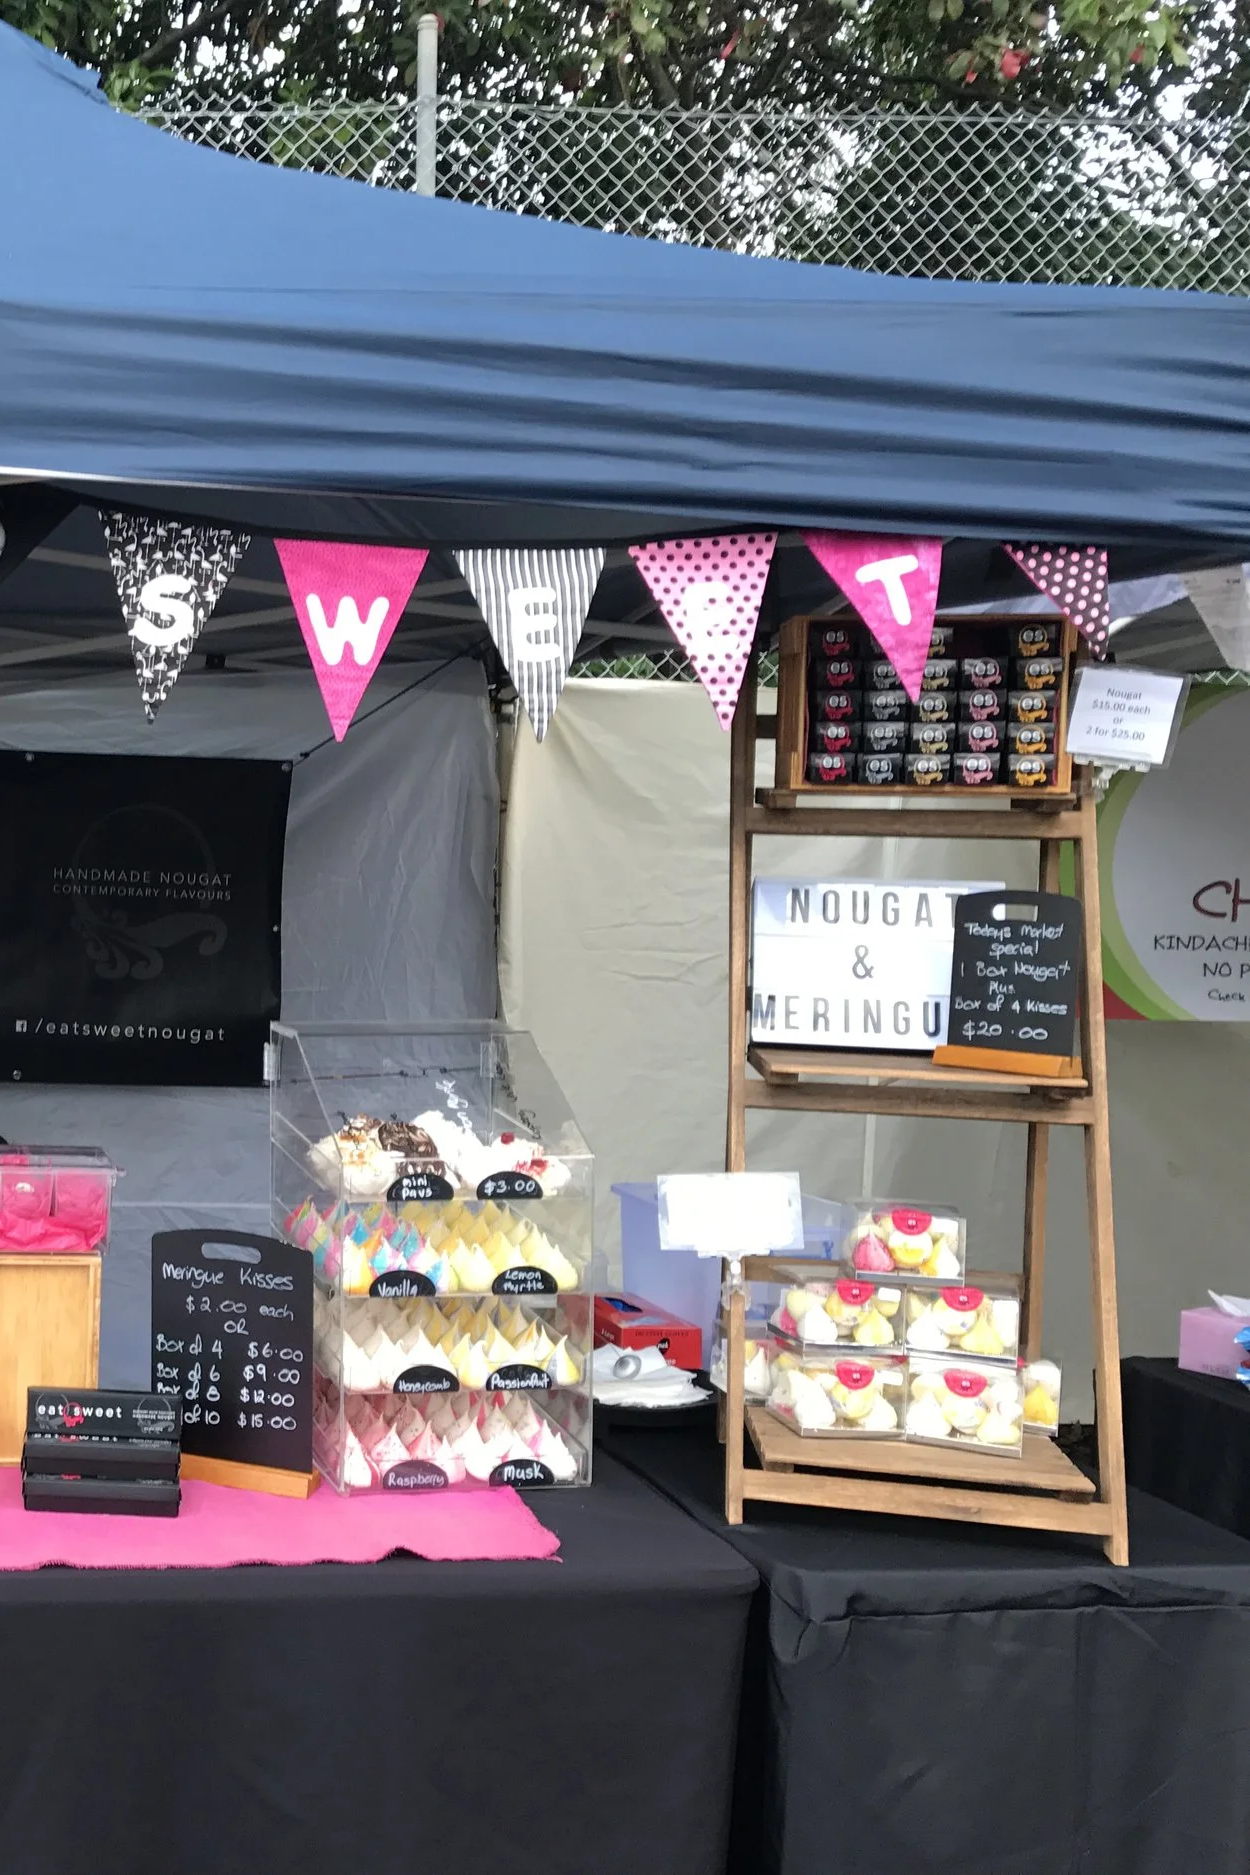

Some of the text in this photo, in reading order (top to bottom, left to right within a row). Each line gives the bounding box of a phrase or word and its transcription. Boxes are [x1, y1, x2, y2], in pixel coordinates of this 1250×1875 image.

[1106, 688, 1142, 700] Nougat
[1092, 700, 1151, 715] $15.00 each
[1113, 717, 1124, 725] or
[1086, 726, 1145, 741] 2 for $25.00
[53, 867, 232, 887] HANDMADE NOUGAT
[53, 884, 232, 901] CONTEMPORARY FLAVOURS
[791, 887, 962, 928] NOUGAT
[1154, 934, 1250, 951] KINDACH
[852, 944, 875, 979] &
[976, 961, 1008, 977] Box
[1014, 960, 1070, 981] Nougat
[1203, 962, 1232, 978] NO
[955, 996, 982, 1011] Box
[987, 994, 1005, 1012] of
[1011, 1000, 1020, 1014] 4
[484, 1179, 536, 1196] $3.00
[162, 1262, 294, 1291] Meringue Kisses
[377, 1279, 419, 1297] Vanilla
[259, 1304, 294, 1322] each
[155, 1333, 185, 1354] Box
[212, 1339, 223, 1360] 4
[157, 1362, 179, 1380] Box
[210, 1364, 221, 1383] 6
[399, 1378, 451, 1393] Honeycomb
[206, 1385, 221, 1402] 8
[240, 1386, 295, 1407] $12.00
[38, 1404, 64, 1416] eat
[73, 1406, 122, 1419] sweet
[205, 1410, 221, 1426] 10
[237, 1412, 297, 1431] $15.00
[388, 1472, 445, 1487] Raspberry
[504, 1462, 545, 1481] Musk
